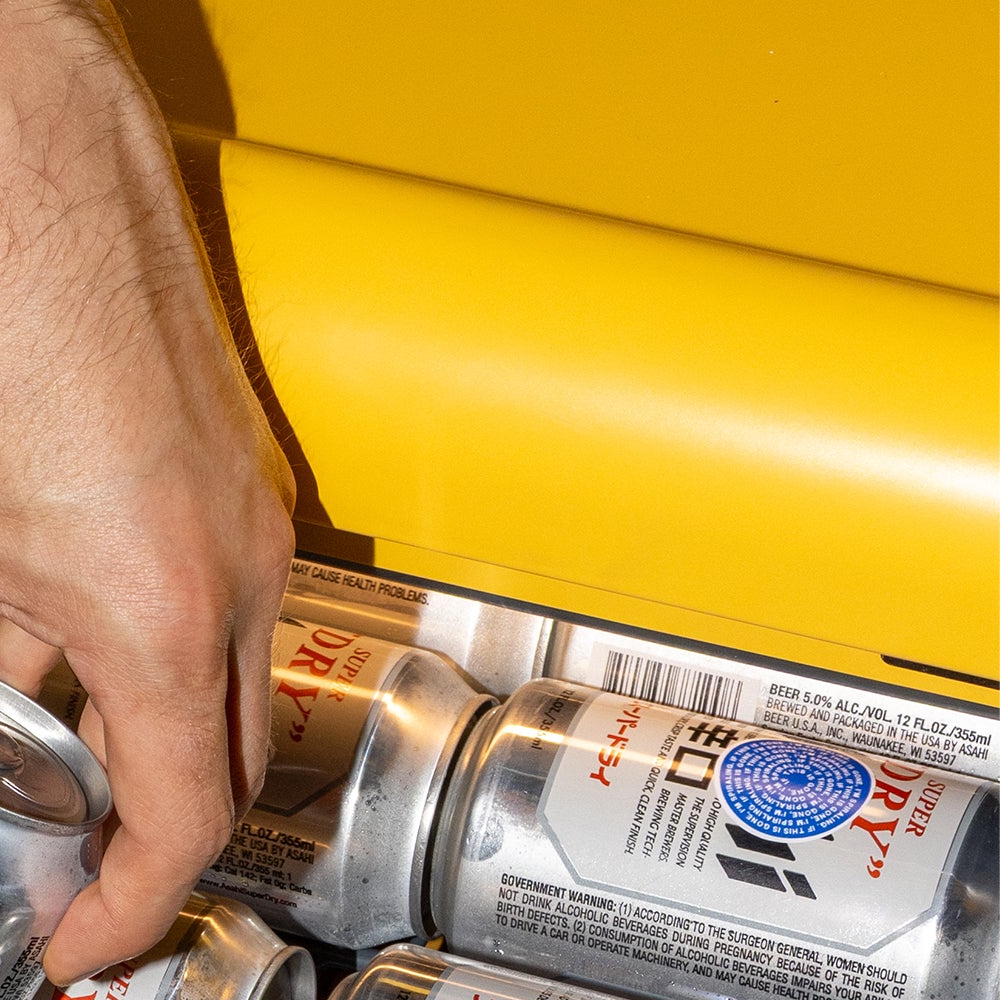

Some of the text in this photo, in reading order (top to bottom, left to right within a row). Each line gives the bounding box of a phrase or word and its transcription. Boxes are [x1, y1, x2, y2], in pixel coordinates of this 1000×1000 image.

[290, 560, 430, 607] MAY CAUSE HEALTH PROBLEMS.
[765, 696, 990, 760] BREWED AND PACKAGED IN THE USA BY ASAHI
[769, 683, 800, 701] BEER
[802, 690, 834, 708] 5.0%
[895, 712, 911, 727] 12
[763, 710, 791, 727] BEER
[825, 725, 850, 742] INC.,
[851, 730, 909, 758] WAUNAKEE,
[909, 744, 923, 758] WI
[923, 748, 956, 767] 53597
[905, 779, 946, 838] SUPER
[498, 887, 905, 999] NOT DRINK ALCOHOLIC BEVERAGES DURING PREGNANCY BECAUSE OF THE RISK OF
[500, 872, 908, 985] GOVERNMENT WARNING: (1) ACCORDING TO THE SURGEON GENERAL, WOMEN SHOULD
